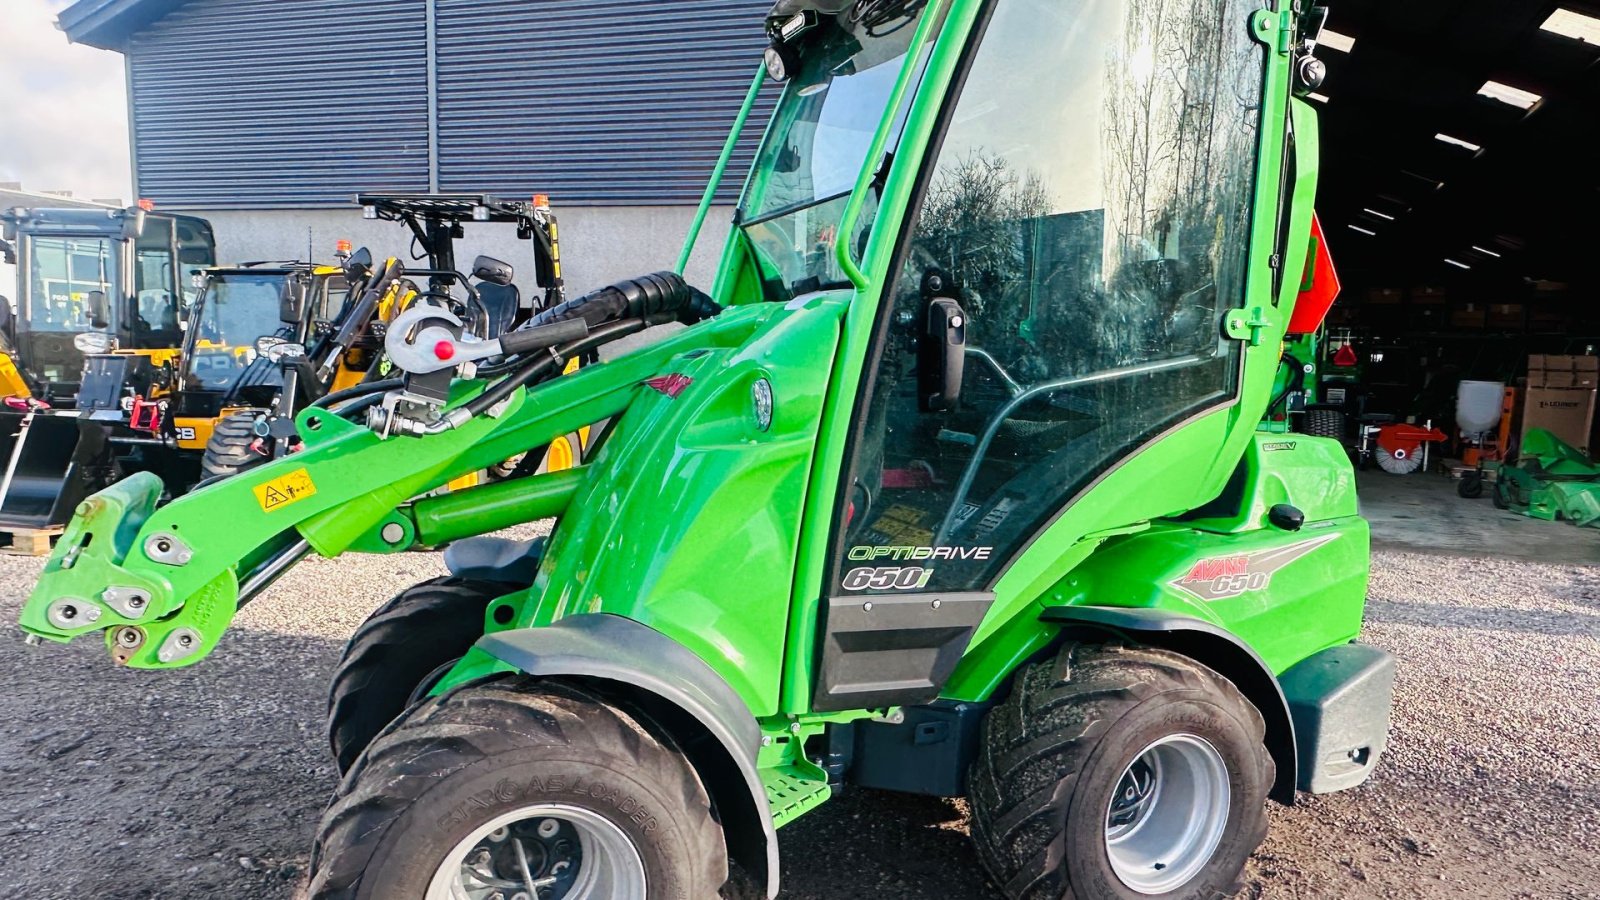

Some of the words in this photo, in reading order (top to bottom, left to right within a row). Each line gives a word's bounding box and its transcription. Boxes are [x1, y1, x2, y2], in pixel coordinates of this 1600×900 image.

[847, 545, 994, 561] OPTIDRIVE
[841, 566, 935, 591] 650i
[1182, 556, 1249, 584] AVANT
[523, 773, 567, 799] AS
[572, 775, 659, 836] LOADER
